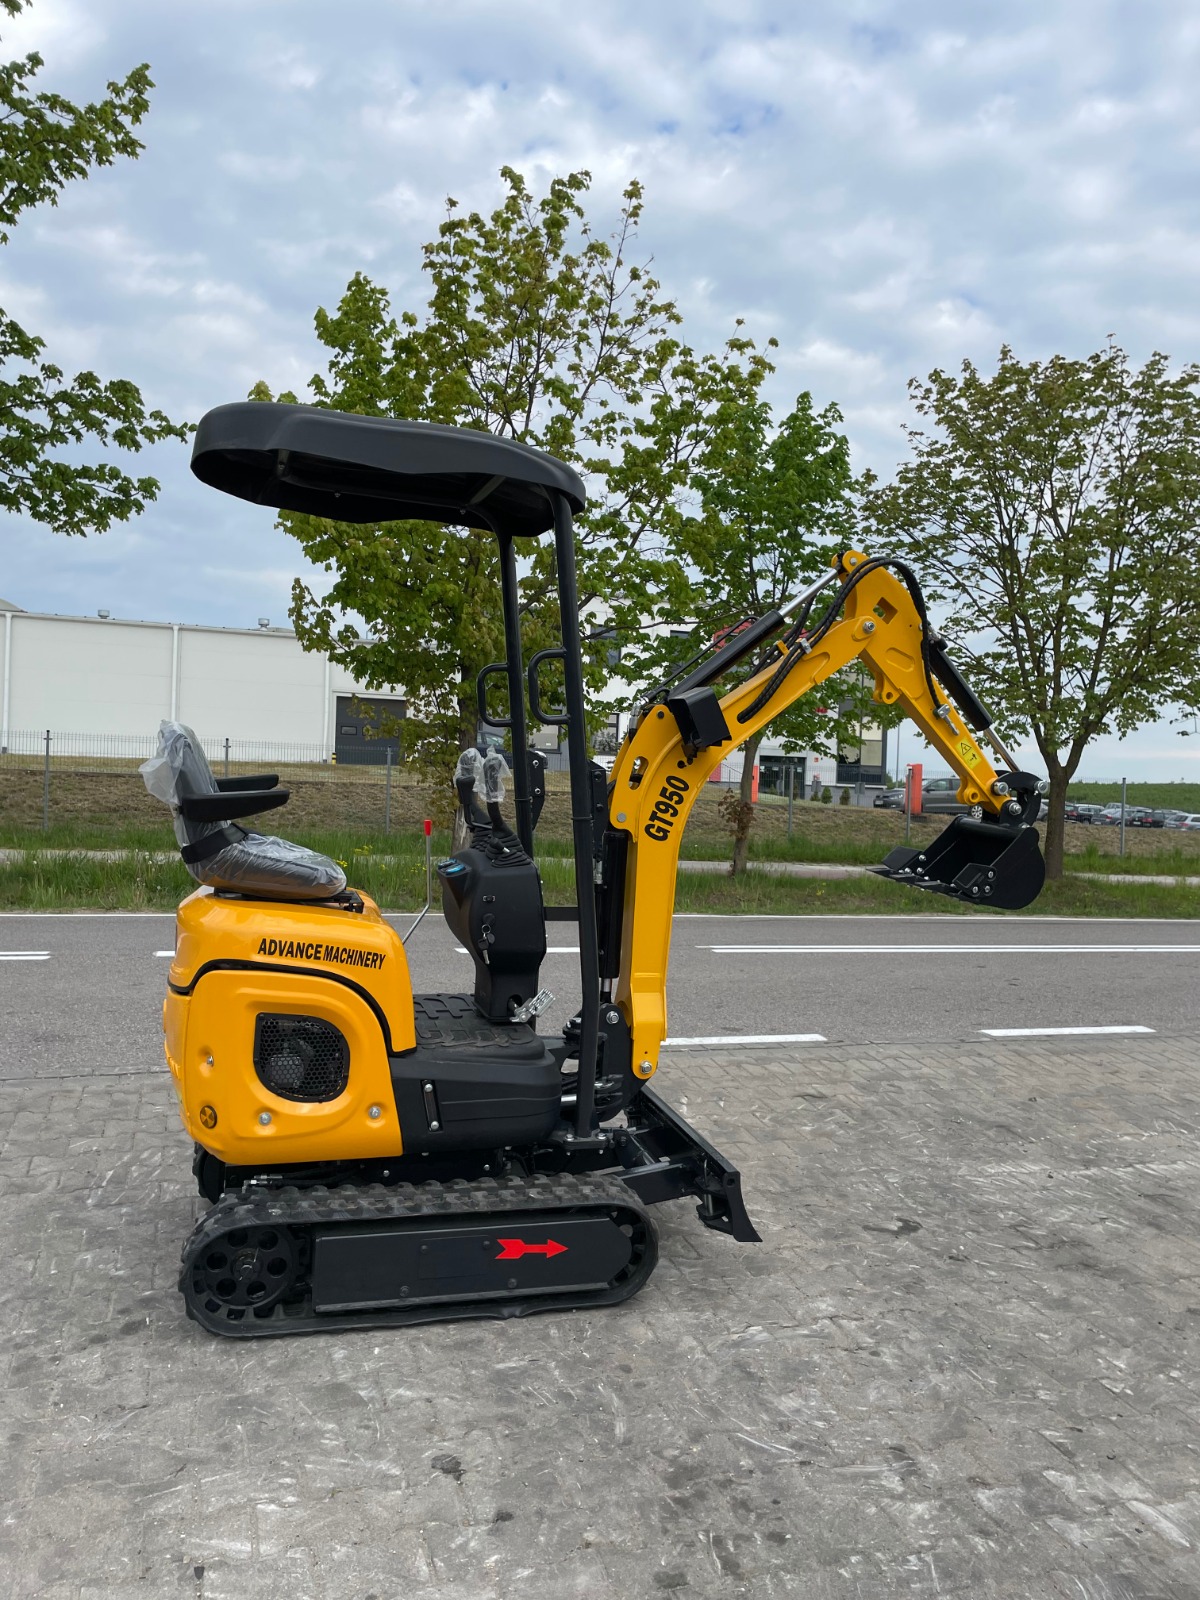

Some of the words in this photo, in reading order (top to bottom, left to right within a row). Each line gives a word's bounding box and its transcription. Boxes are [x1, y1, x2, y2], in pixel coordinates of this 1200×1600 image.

[644, 775, 689, 841] GT950
[257, 938, 323, 960] ADVANCE
[323, 945, 386, 970] MACHINERY
